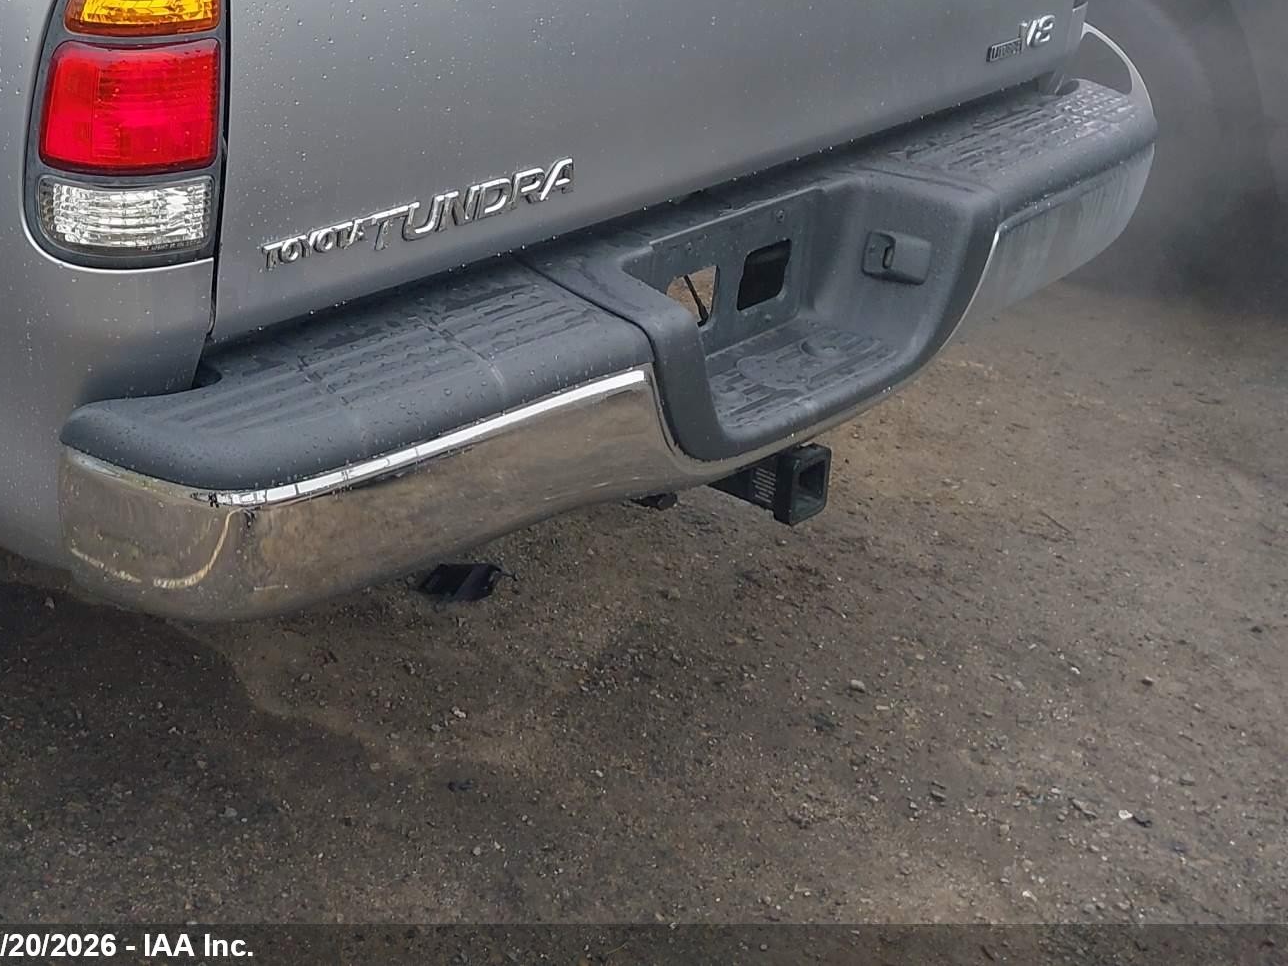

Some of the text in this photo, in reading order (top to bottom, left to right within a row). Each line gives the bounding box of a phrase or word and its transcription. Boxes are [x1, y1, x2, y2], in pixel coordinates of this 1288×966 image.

[1018, 14, 1055, 47] V8
[262, 156, 575, 269] TOYOTA TUNDRA
